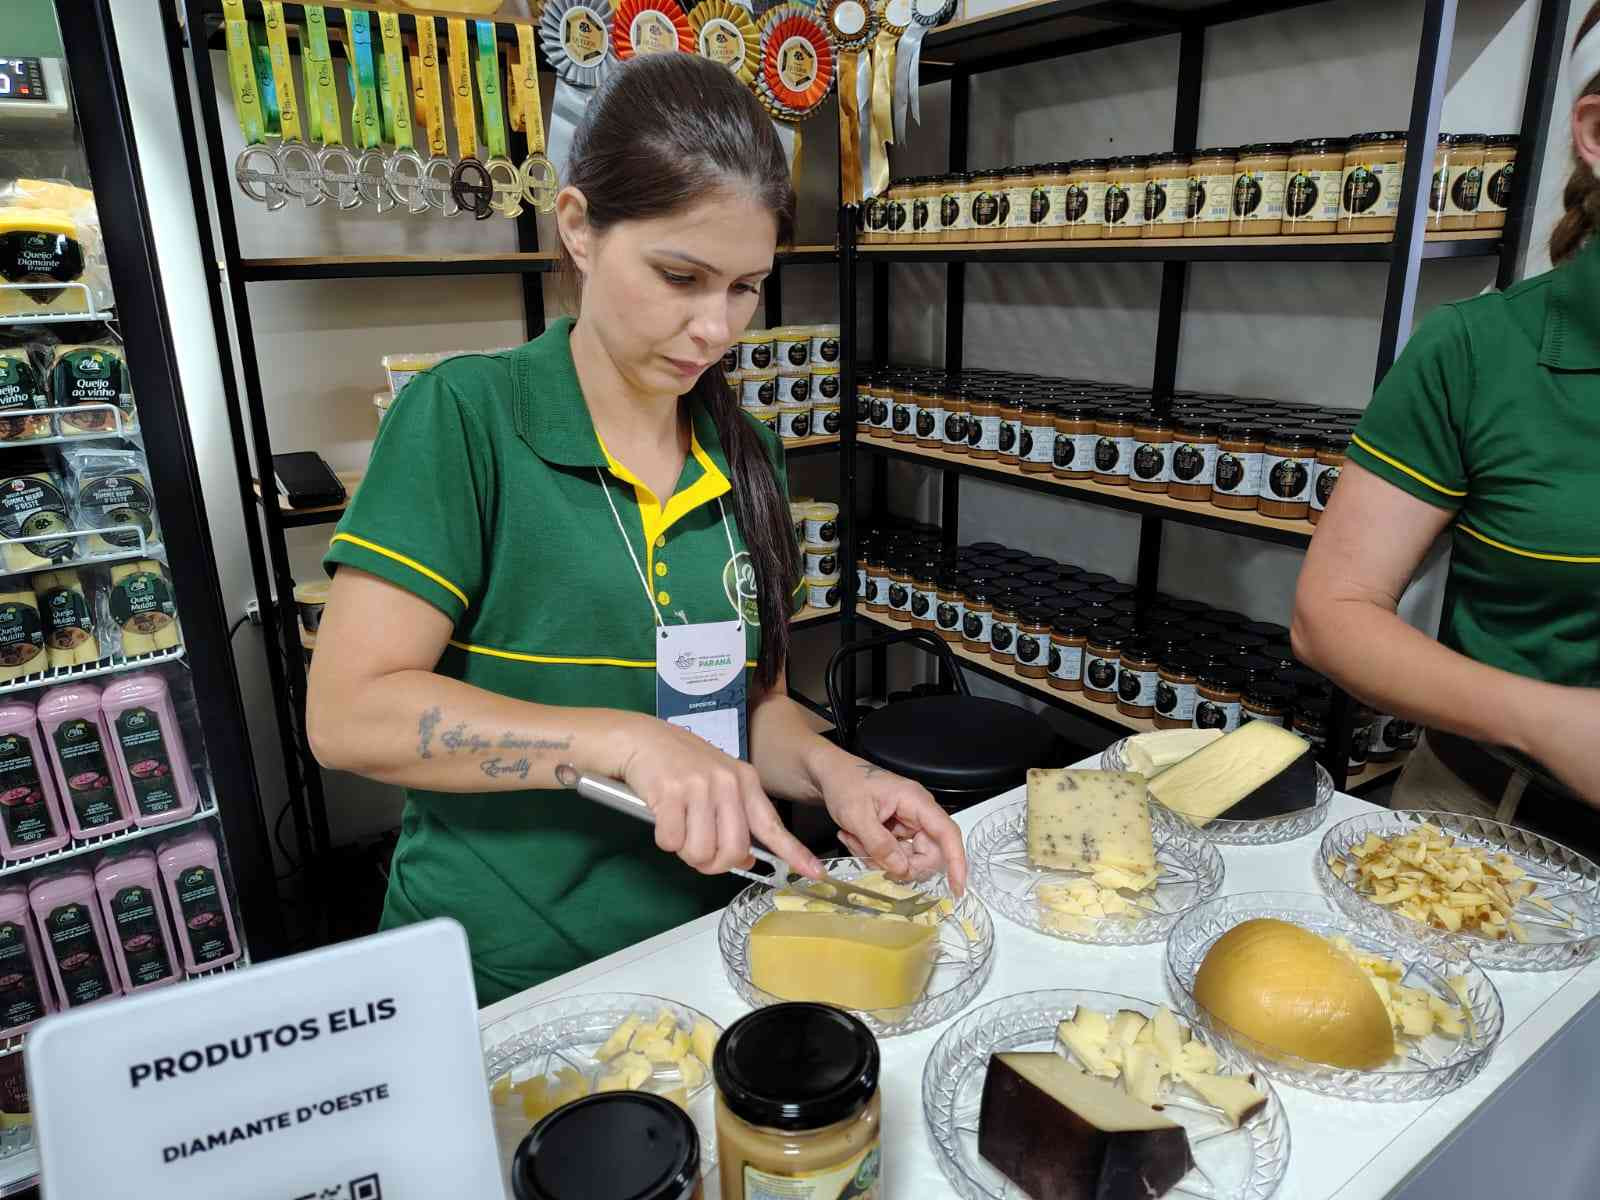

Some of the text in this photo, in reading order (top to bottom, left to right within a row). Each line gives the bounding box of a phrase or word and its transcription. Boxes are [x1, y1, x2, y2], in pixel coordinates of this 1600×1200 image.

[77, 379, 109, 390] Queijo
[87, 388, 116, 398] vinho
[129, 998, 398, 1088] PRODUTOS ELIS
[162, 1083, 390, 1164] DIAMANTE D'OESTE
